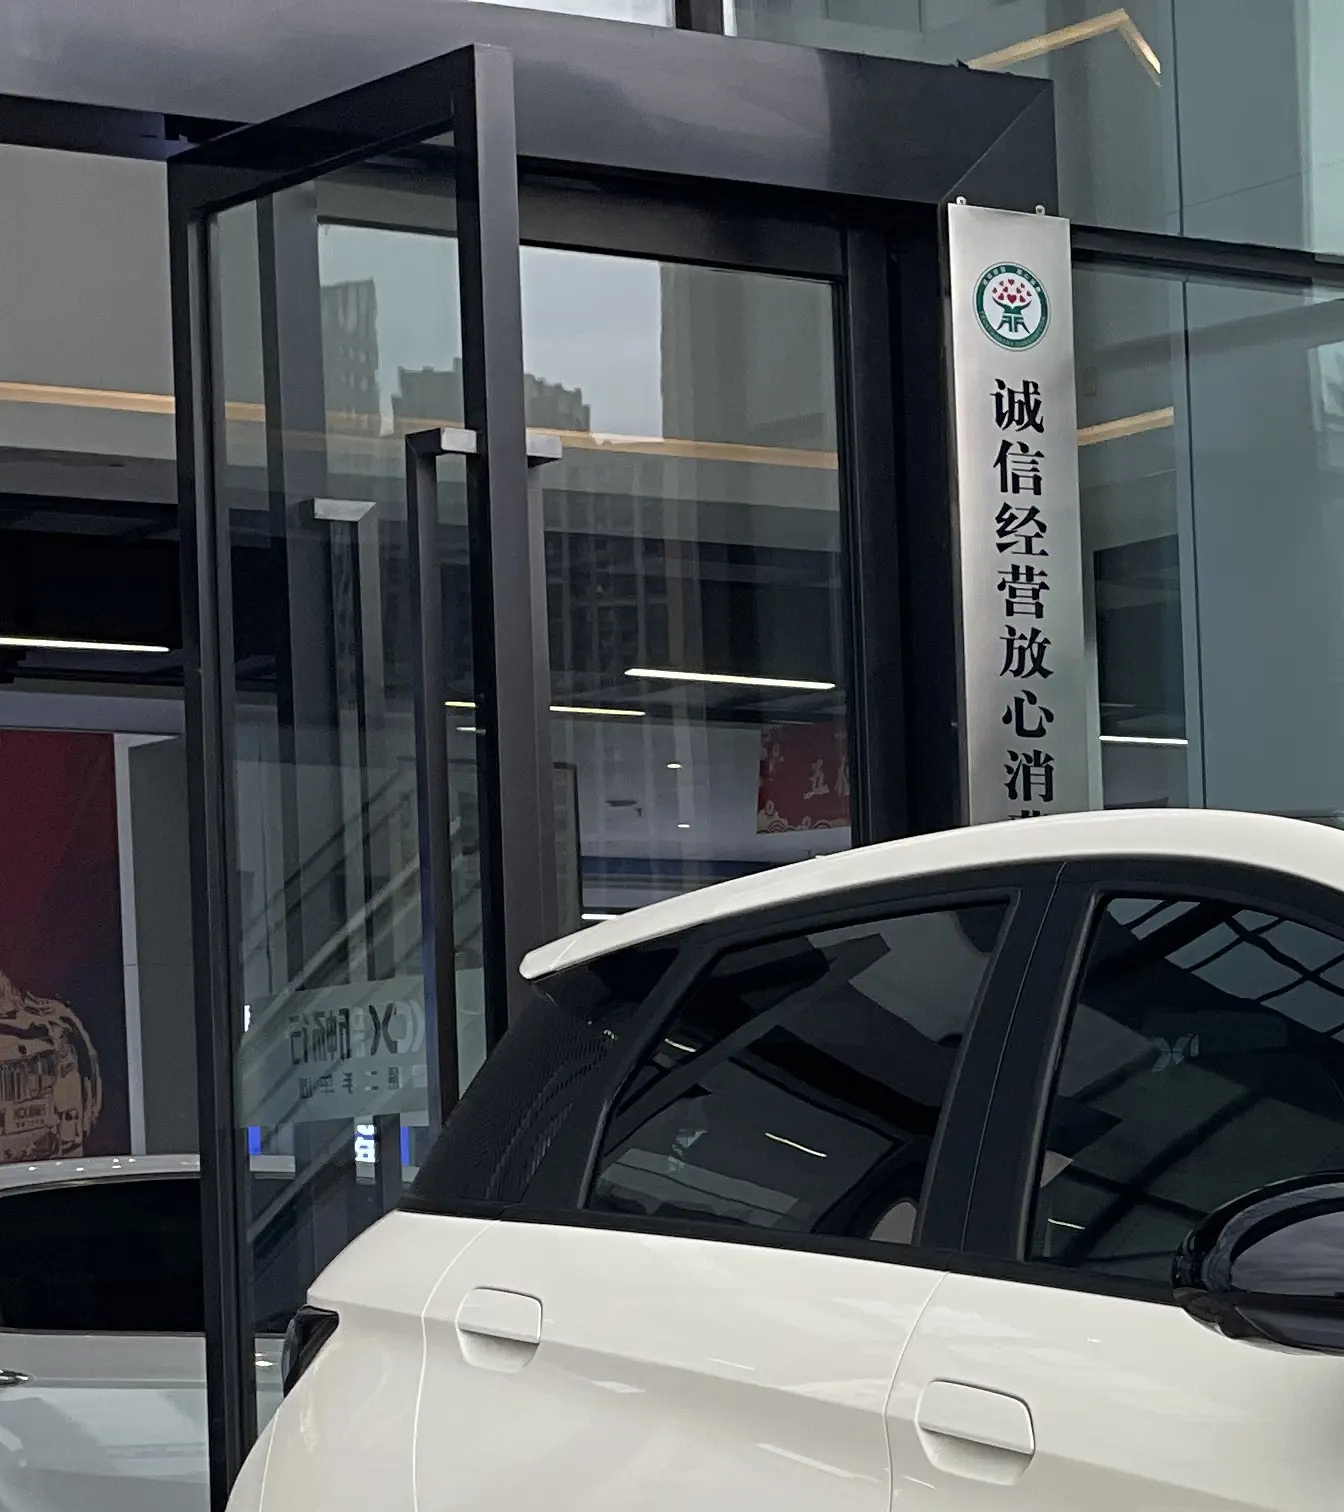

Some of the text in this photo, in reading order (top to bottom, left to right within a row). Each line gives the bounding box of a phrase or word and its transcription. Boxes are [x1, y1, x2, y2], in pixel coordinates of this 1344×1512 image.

[989, 377, 1055, 820] 诚信经营放心消
